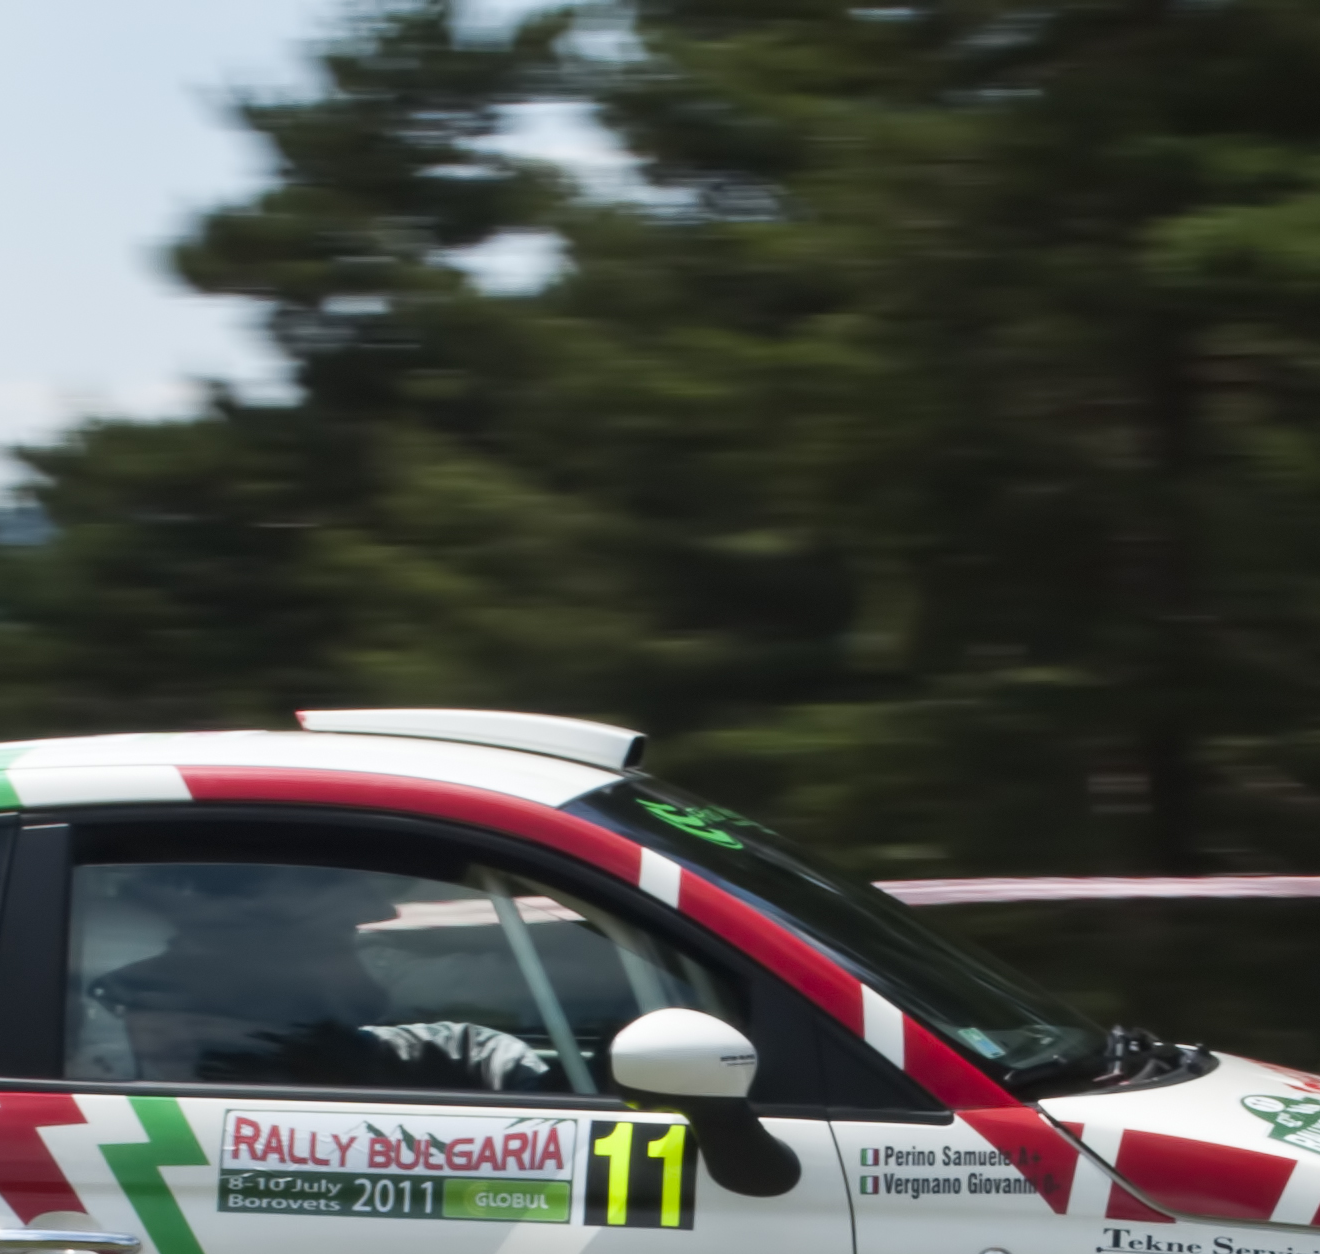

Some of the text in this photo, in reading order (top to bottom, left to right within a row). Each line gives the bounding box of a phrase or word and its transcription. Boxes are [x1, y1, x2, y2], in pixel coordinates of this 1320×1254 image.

[231, 1116, 564, 1172] RALLY BULGARIA
[884, 1145, 935, 1166] Perino
[942, 1145, 1011, 1167] Samuele
[593, 1121, 686, 1228] 11
[883, 1173, 962, 1200] Vergnano
[967, 1173, 1038, 1195] Giovanni
[228, 1177, 435, 1214] 8-10 July 2011
[228, 1194, 341, 1213] Borovets
[475, 1191, 549, 1209] GLOBUL
[1103, 1227, 1202, 1254] Tekne
